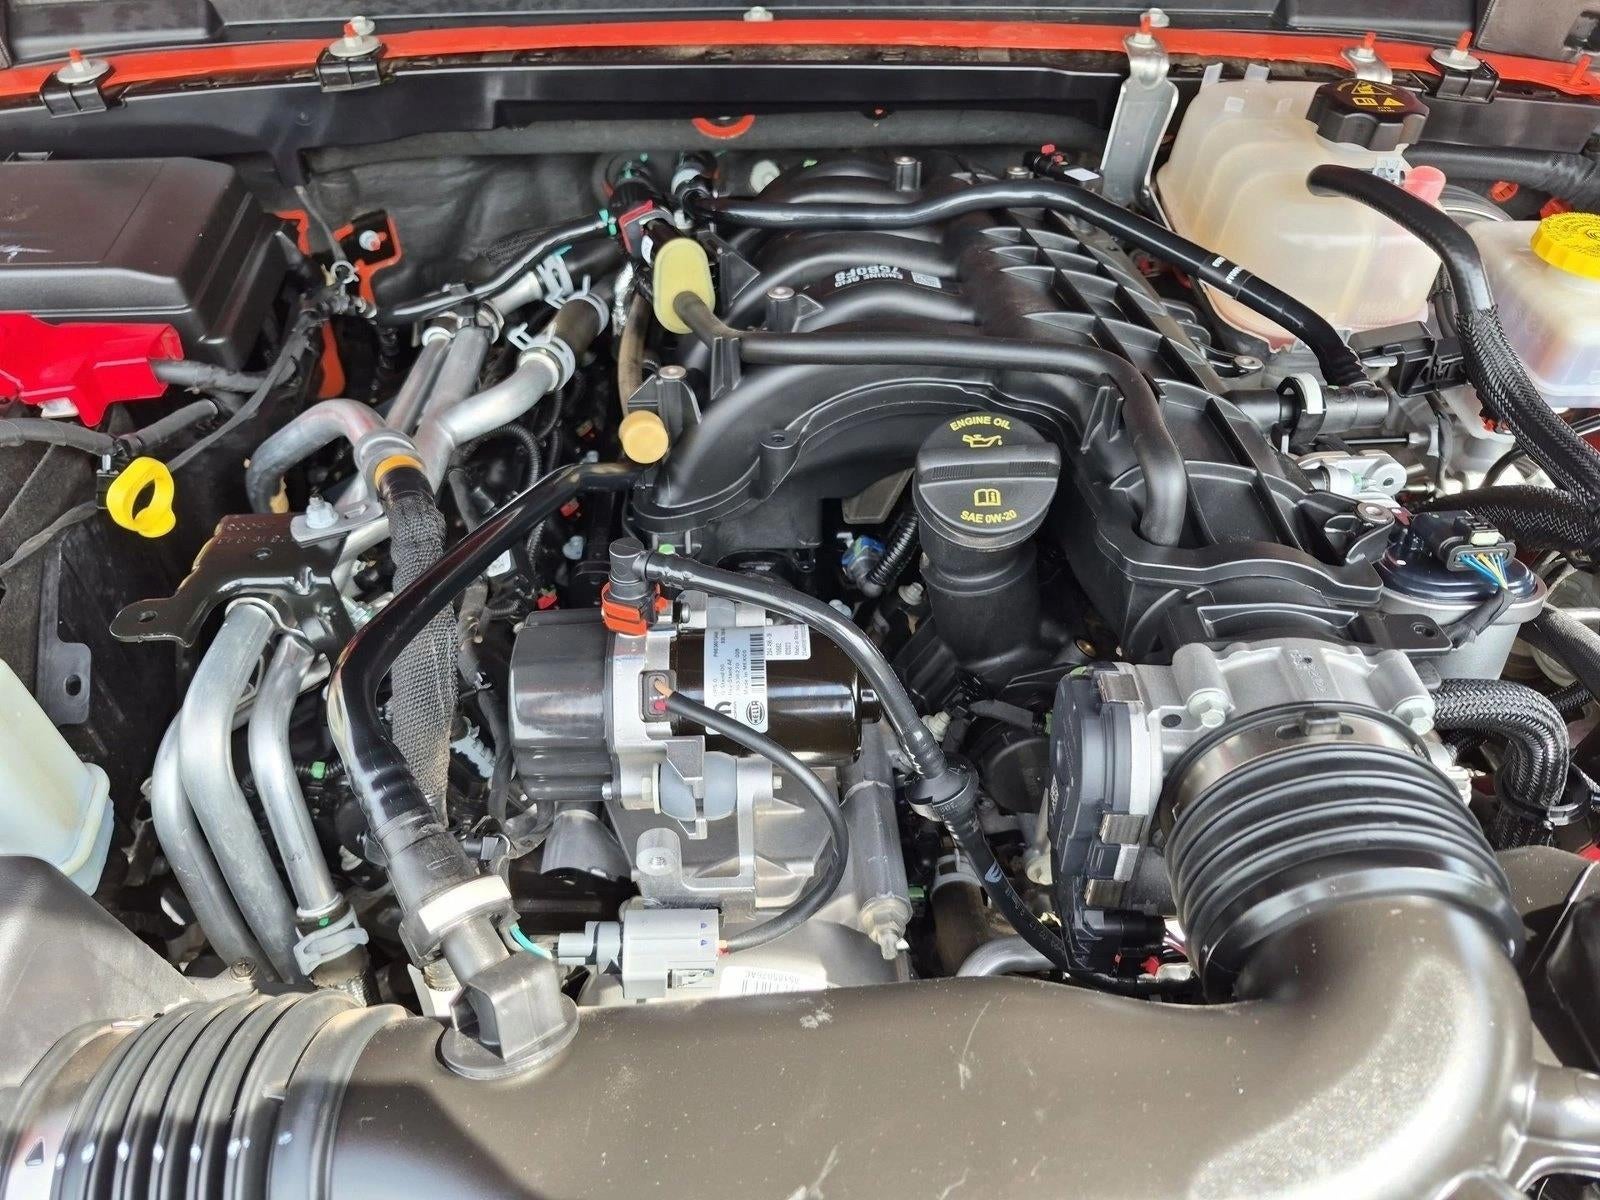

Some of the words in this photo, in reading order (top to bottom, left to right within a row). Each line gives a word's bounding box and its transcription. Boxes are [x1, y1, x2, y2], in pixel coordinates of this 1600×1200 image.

[862, 272, 903, 280] ENGINE
[950, 416, 991, 431] ENGINE
[993, 418, 1011, 430] OIL
[960, 510, 983, 523] SAE
[985, 509, 1017, 523] 0W-20
[750, 700, 760, 723] HELLA
